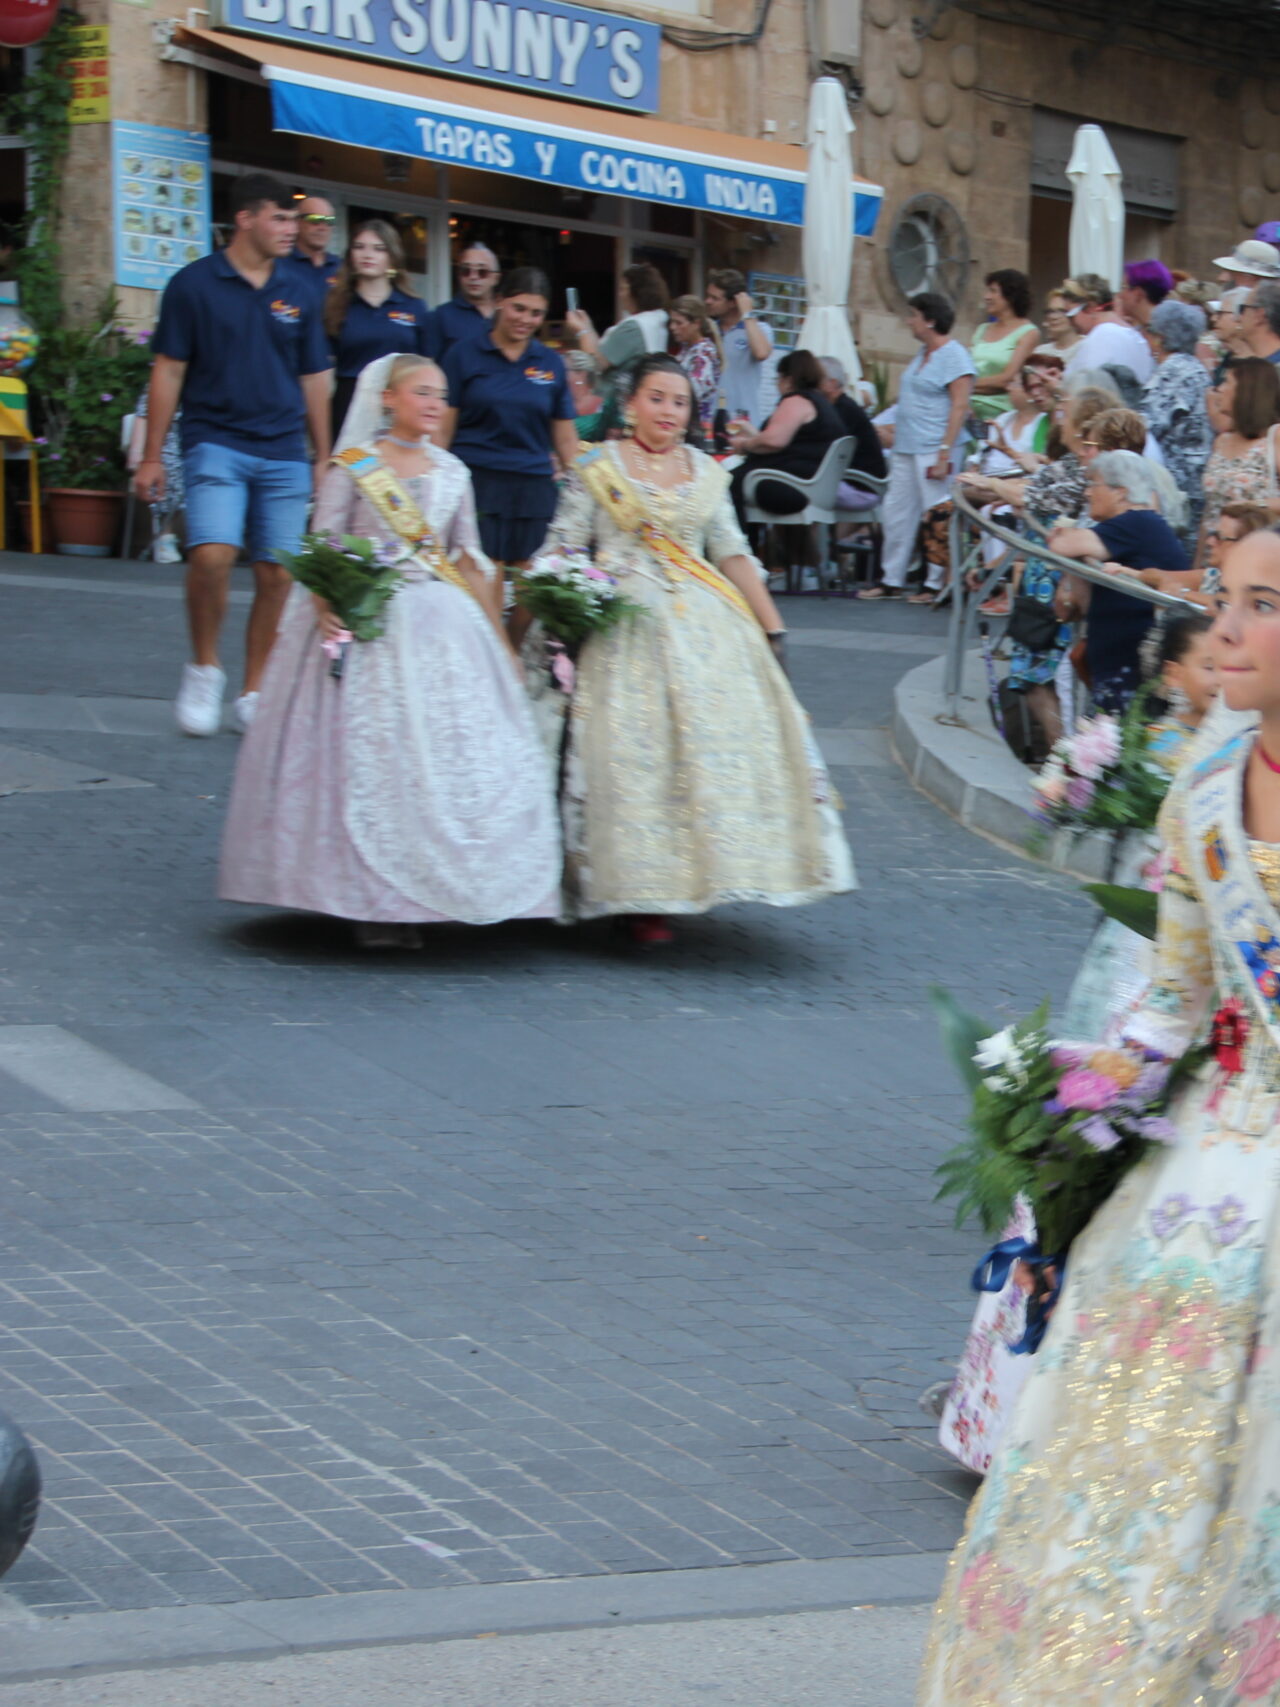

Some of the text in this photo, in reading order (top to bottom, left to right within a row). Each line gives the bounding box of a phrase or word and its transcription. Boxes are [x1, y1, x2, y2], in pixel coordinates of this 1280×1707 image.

[390, 0, 643, 98] SUNNY'S
[415, 117, 778, 216] TAPAS Y COCINA INDIA
